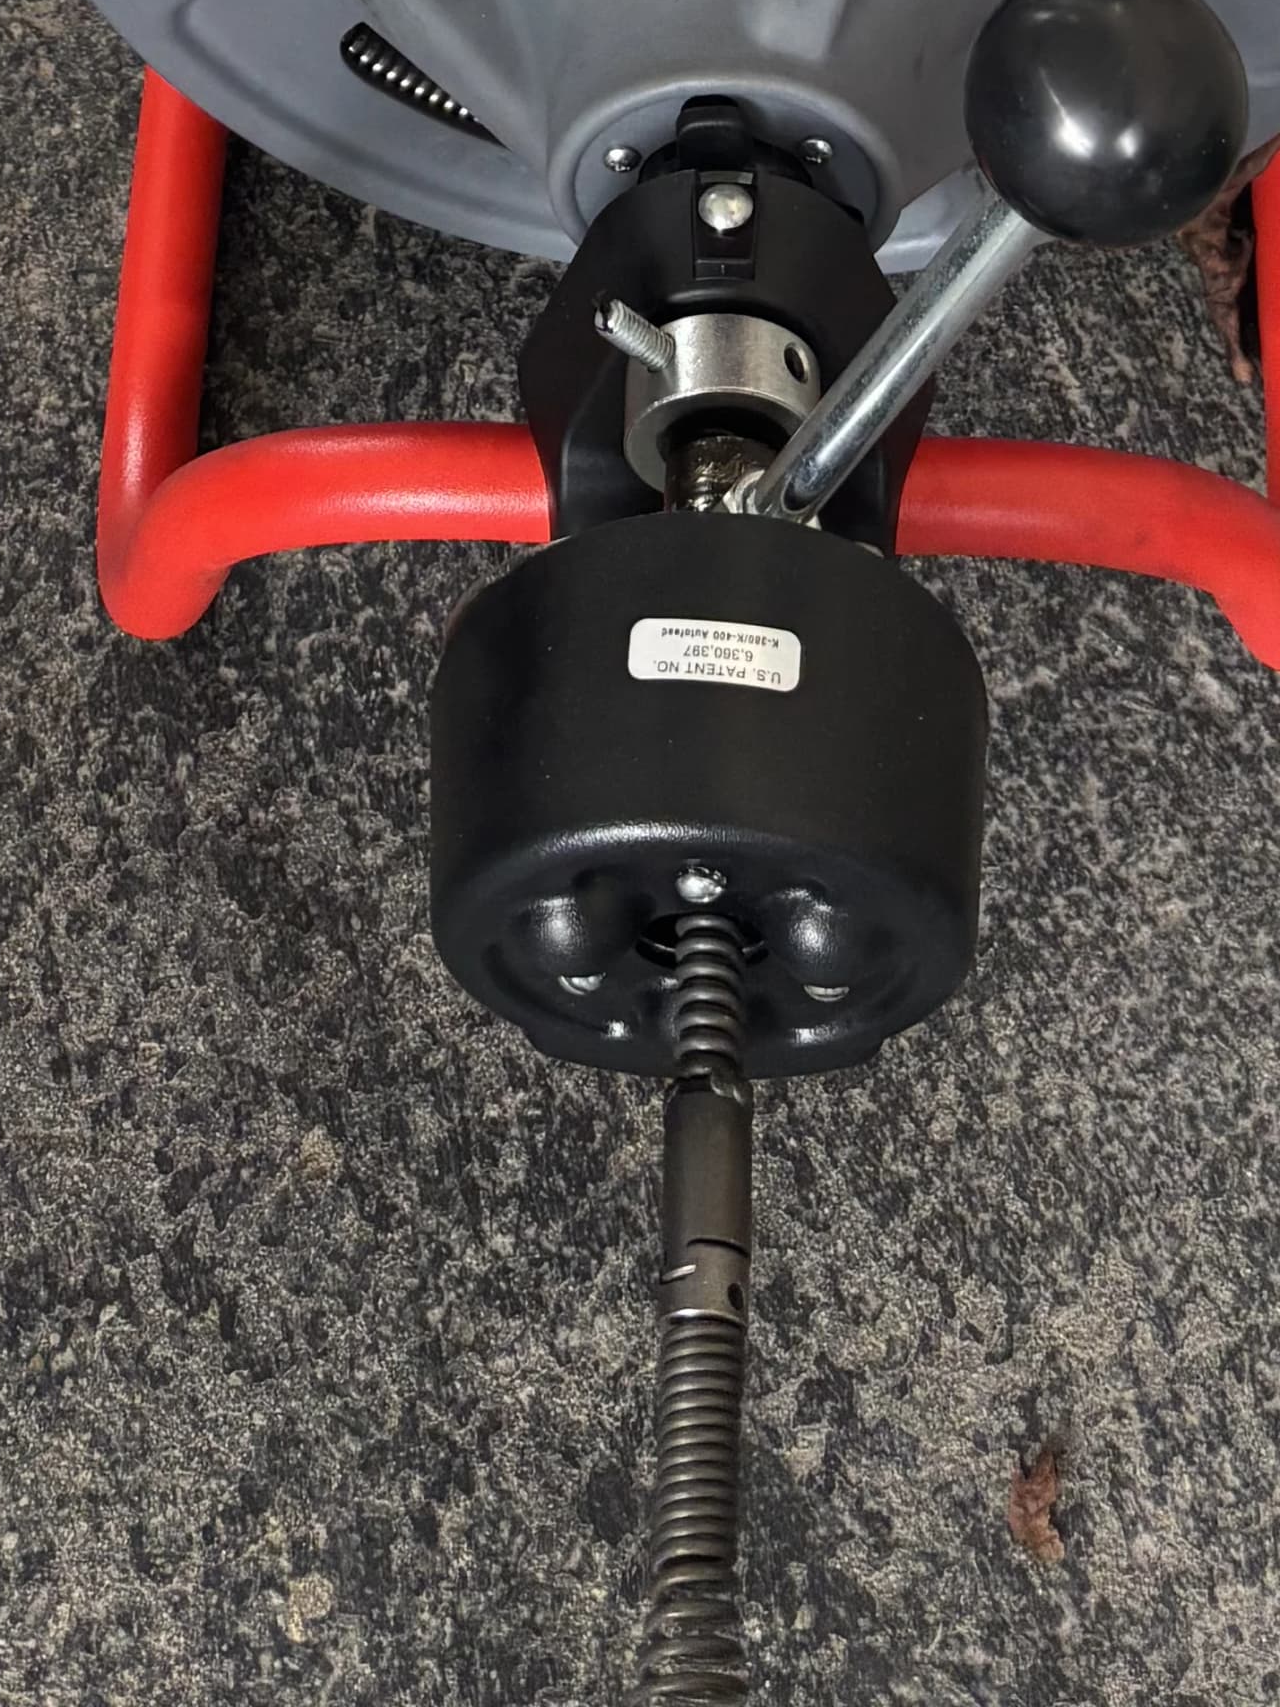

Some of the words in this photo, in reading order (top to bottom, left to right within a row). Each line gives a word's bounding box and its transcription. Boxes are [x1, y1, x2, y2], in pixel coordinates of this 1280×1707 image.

[682, 643, 754, 663] 6,360,397
[652, 659, 680, 674] NO.
[684, 660, 747, 679] PATENT
[752, 668, 782, 685] U.S.
